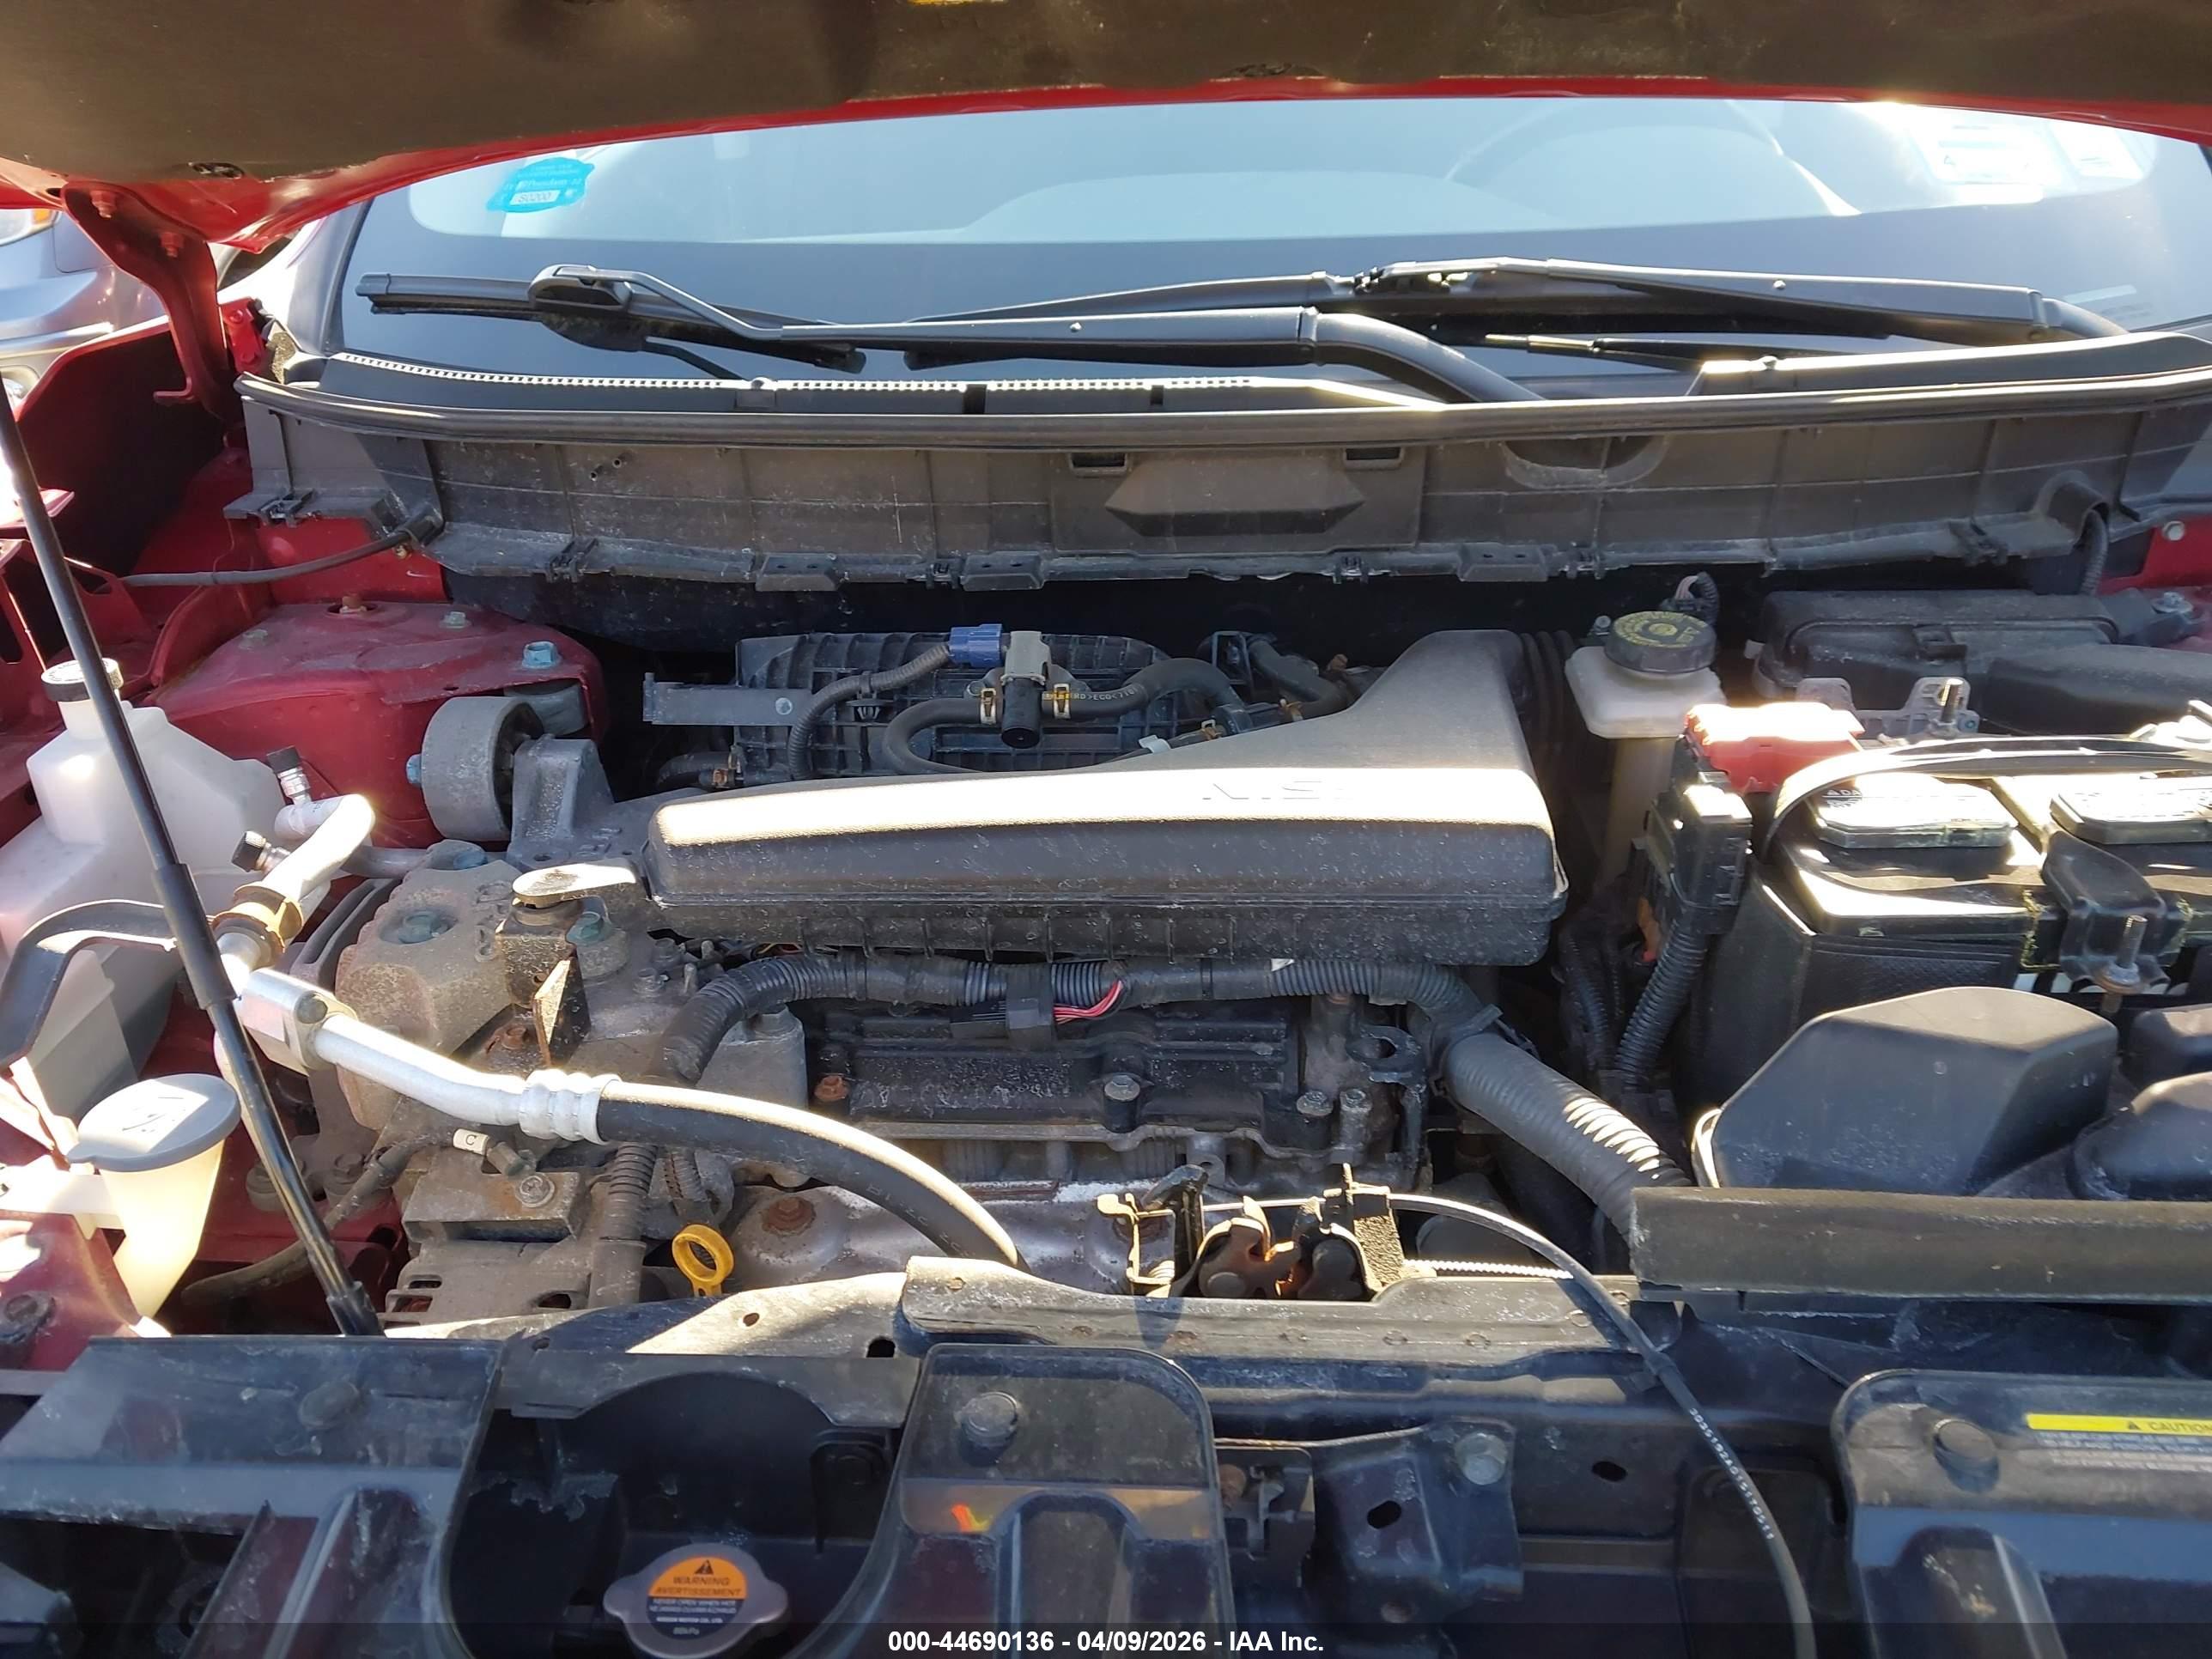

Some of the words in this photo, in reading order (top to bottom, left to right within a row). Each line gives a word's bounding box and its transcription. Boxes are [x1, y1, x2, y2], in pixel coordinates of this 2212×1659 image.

[466, 1134, 477, 1145] C
[672, 1576, 730, 1586] WARNING
[655, 1586, 742, 1596] AVERTISSEMENT
